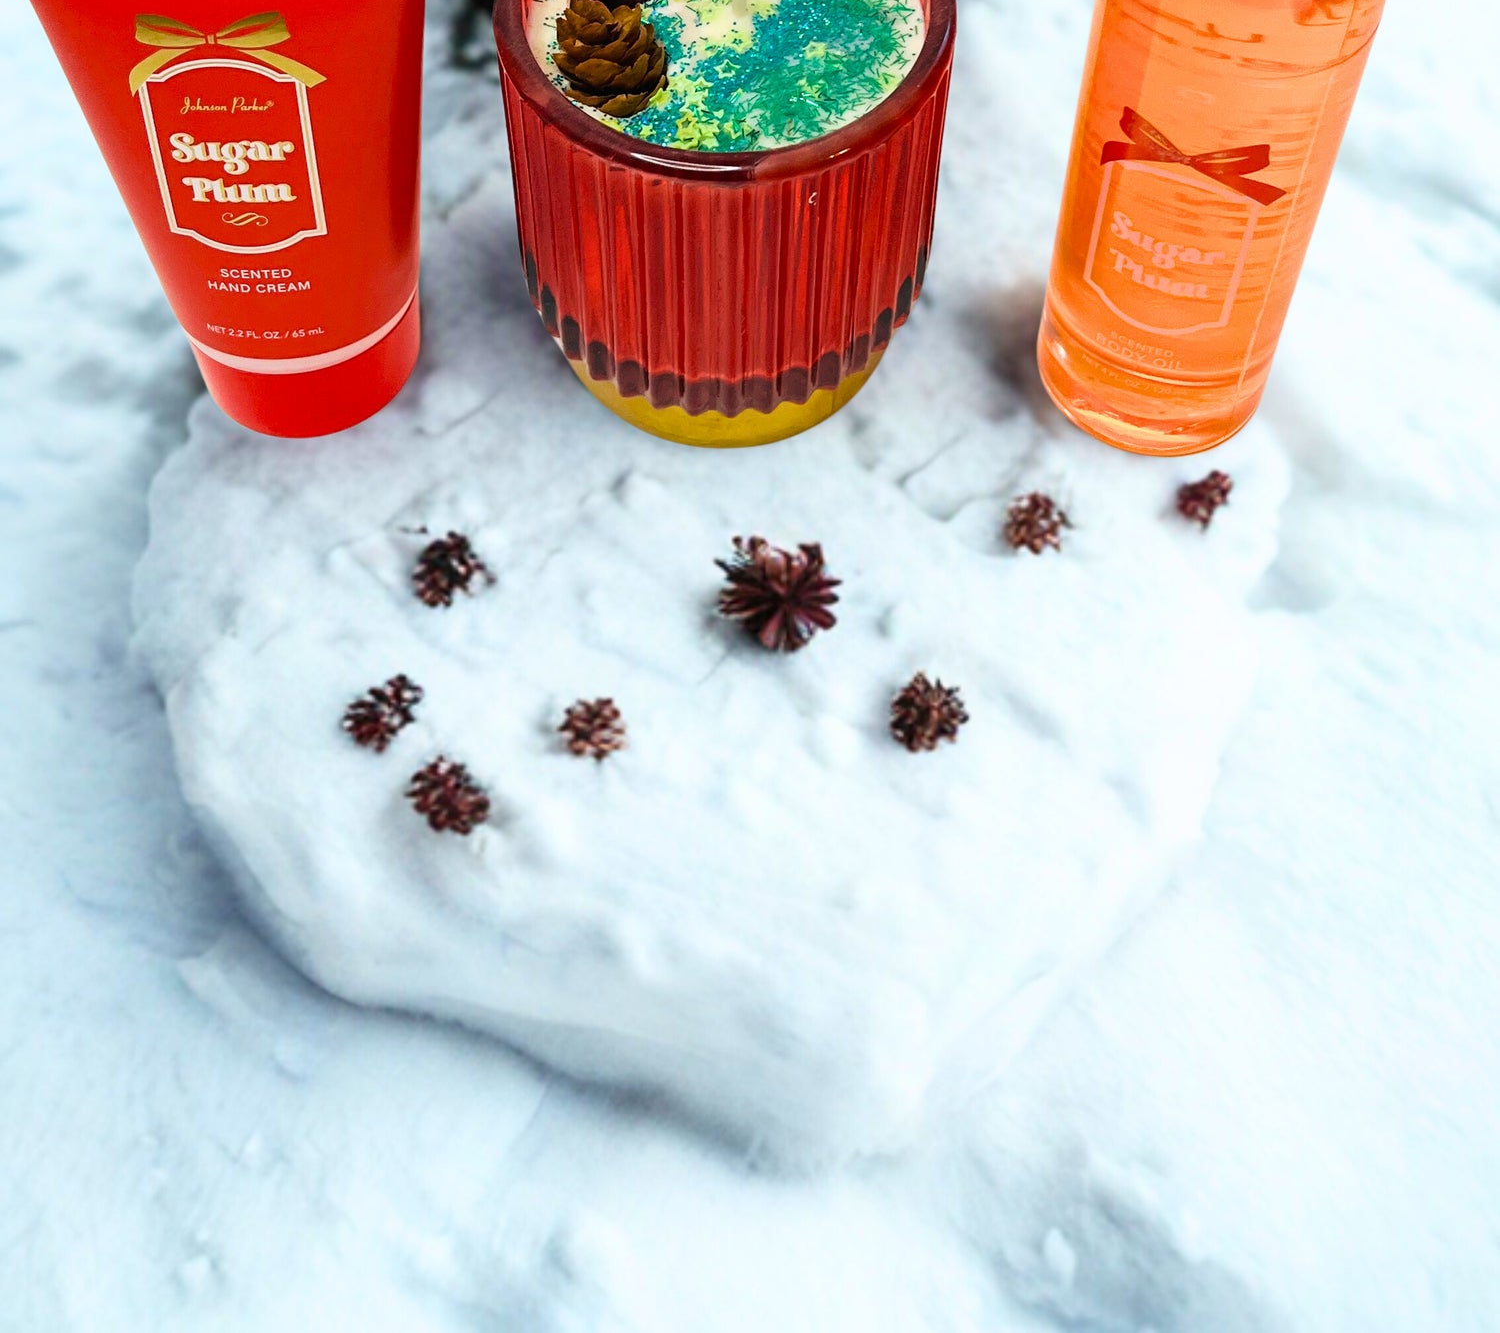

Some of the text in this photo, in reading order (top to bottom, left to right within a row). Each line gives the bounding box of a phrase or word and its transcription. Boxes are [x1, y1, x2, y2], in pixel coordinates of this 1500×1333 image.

[180, 96, 227, 115] Johnson
[169, 132, 295, 176] Sugar
[181, 177, 298, 203] Plum
[1110, 210, 1226, 270] Sugar
[220, 268, 292, 279] SCENTED
[1109, 246, 1209, 299] Plum
[207, 280, 311, 293] HAND CREAM
[206, 323, 227, 335] NET
[228, 328, 244, 338] 2.2
[292, 329, 306, 339] 65
[308, 326, 325, 336] mL
